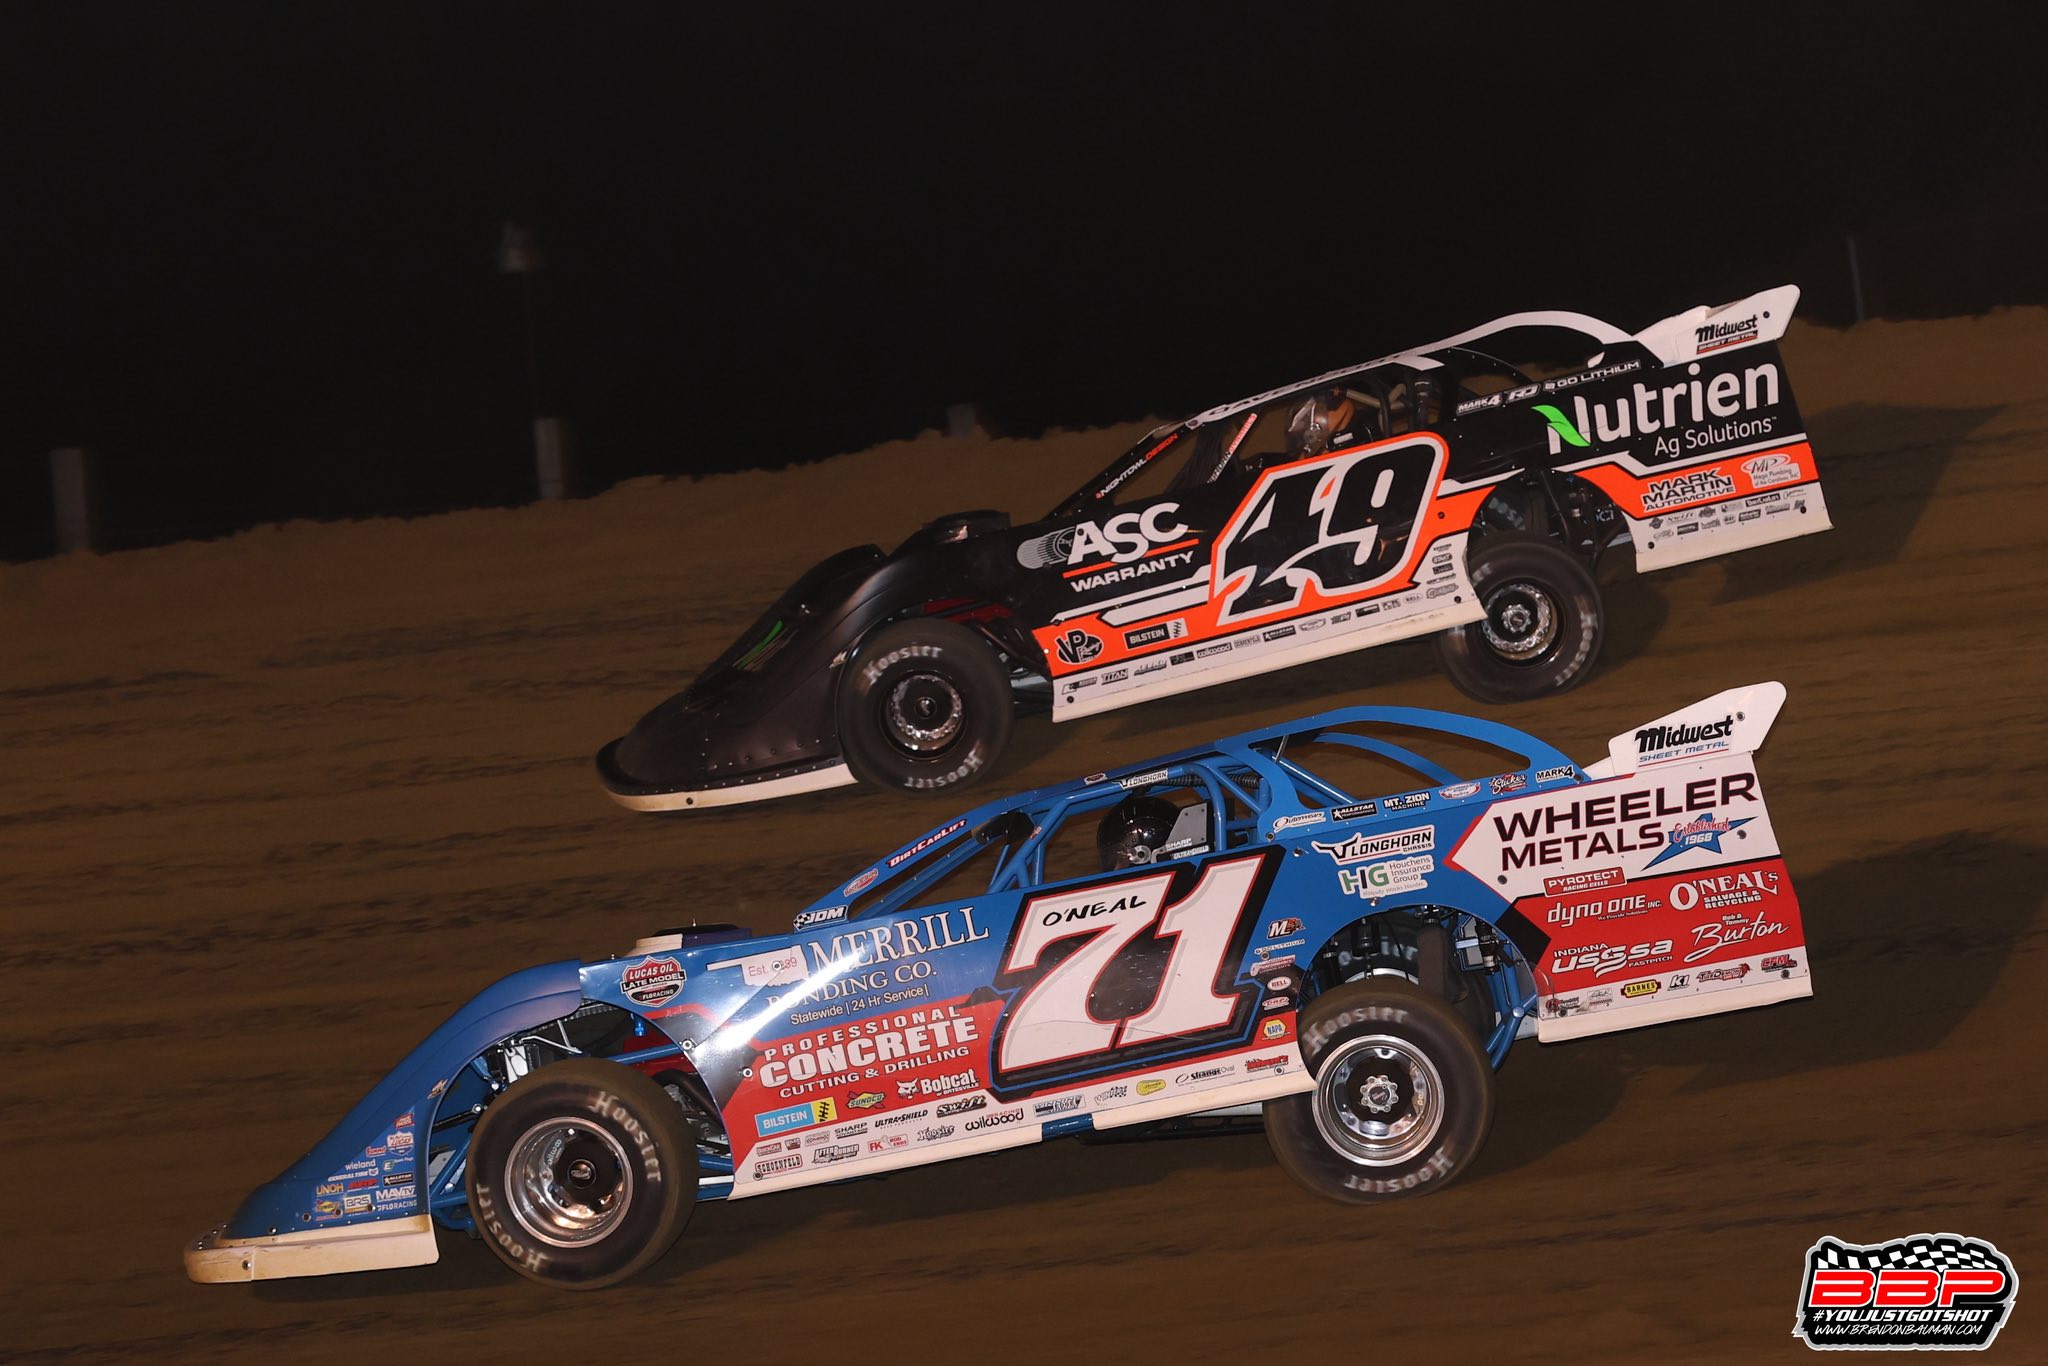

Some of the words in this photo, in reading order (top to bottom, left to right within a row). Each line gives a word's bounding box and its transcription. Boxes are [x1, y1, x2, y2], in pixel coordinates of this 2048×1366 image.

[1695, 314, 1758, 343] Midwest
[1581, 361, 1640, 381] LITHIUM
[1532, 361, 1780, 455] Nutrien
[1655, 435, 1680, 458] Ag
[1686, 415, 1773, 449] Solutions
[1642, 476, 1732, 505] MARTIN
[1650, 469, 1719, 493] MARK
[1645, 486, 1735, 511] AUTOMOTIVE
[1068, 502, 1189, 566] ASC
[1217, 440, 1442, 619] 49
[1071, 551, 1194, 592] WARRANTY
[1055, 629, 1087, 663] VP
[1129, 628, 1165, 644] BILSTEIN
[1635, 715, 1733, 753] Midwest
[1639, 749, 1682, 763] SHEET
[1685, 741, 1729, 756] METAL
[1340, 803, 1374, 814] ALLSTAR
[1384, 798, 1404, 809] MT.
[1406, 793, 1430, 804] ZION
[1392, 801, 1425, 812] MACHINE
[1494, 772, 1758, 843] WHEELER
[1673, 816, 1732, 843] Established
[1685, 832, 1714, 846] 1968
[1351, 831, 1432, 857] LONGHORN
[1402, 843, 1432, 853] CHASSIS
[1501, 821, 1666, 871] METALS
[1389, 856, 1431, 870] Houchens
[1391, 863, 1431, 877] Insurance
[1341, 865, 1390, 892] HIG
[1393, 873, 1419, 884] Group
[1548, 869, 1619, 888] PYROTECT
[1563, 882, 1588, 892] RACING
[1704, 890, 1749, 904] SALVAGE
[1705, 894, 1762, 909] RECYCLING
[1043, 895, 1147, 927] O'NEAL
[808, 906, 989, 973] MERRILL
[1684, 911, 1789, 963] Burton
[1554, 942, 1609, 958] INDIANA
[629, 966, 658, 980] LUCAS
[660, 963, 674, 974] OIL
[748, 962, 769, 977] Est.
[894, 960, 938, 983] CO.
[1001, 854, 1266, 1074] 71
[1628, 956, 1674, 968] FASTPITCH
[622, 979, 648, 991] LATE
[648, 972, 684, 984] MODEL
[1626, 981, 1656, 994] BARNES
[642, 989, 674, 1000] FLORACING
[790, 997, 843, 1025] Statewide
[851, 998, 866, 1012] 24
[868, 994, 882, 1008] Hr
[883, 986, 924, 1005] Service
[764, 1005, 962, 1061] PROFESSIONAL
[1267, 1024, 1283, 1034] NAPA
[759, 1017, 979, 1089] CONCRETE
[779, 1072, 860, 1098] CUTTING
[864, 1068, 880, 1079] &
[884, 1046, 970, 1074] DRILLING
[920, 1068, 977, 1095] Bobcat
[850, 1093, 883, 1107] SUNOCO
[762, 1110, 809, 1130] BILSTEIN
[834, 1122, 868, 1135] SHARP
[965, 1107, 1025, 1132] wilwood
[869, 1141, 882, 1152] FK
[345, 1159, 377, 1170] wieland
[757, 1155, 801, 1173] SCHOENFELD
[316, 1183, 343, 1195] UNOH
[382, 1200, 417, 1212] FLORACING
